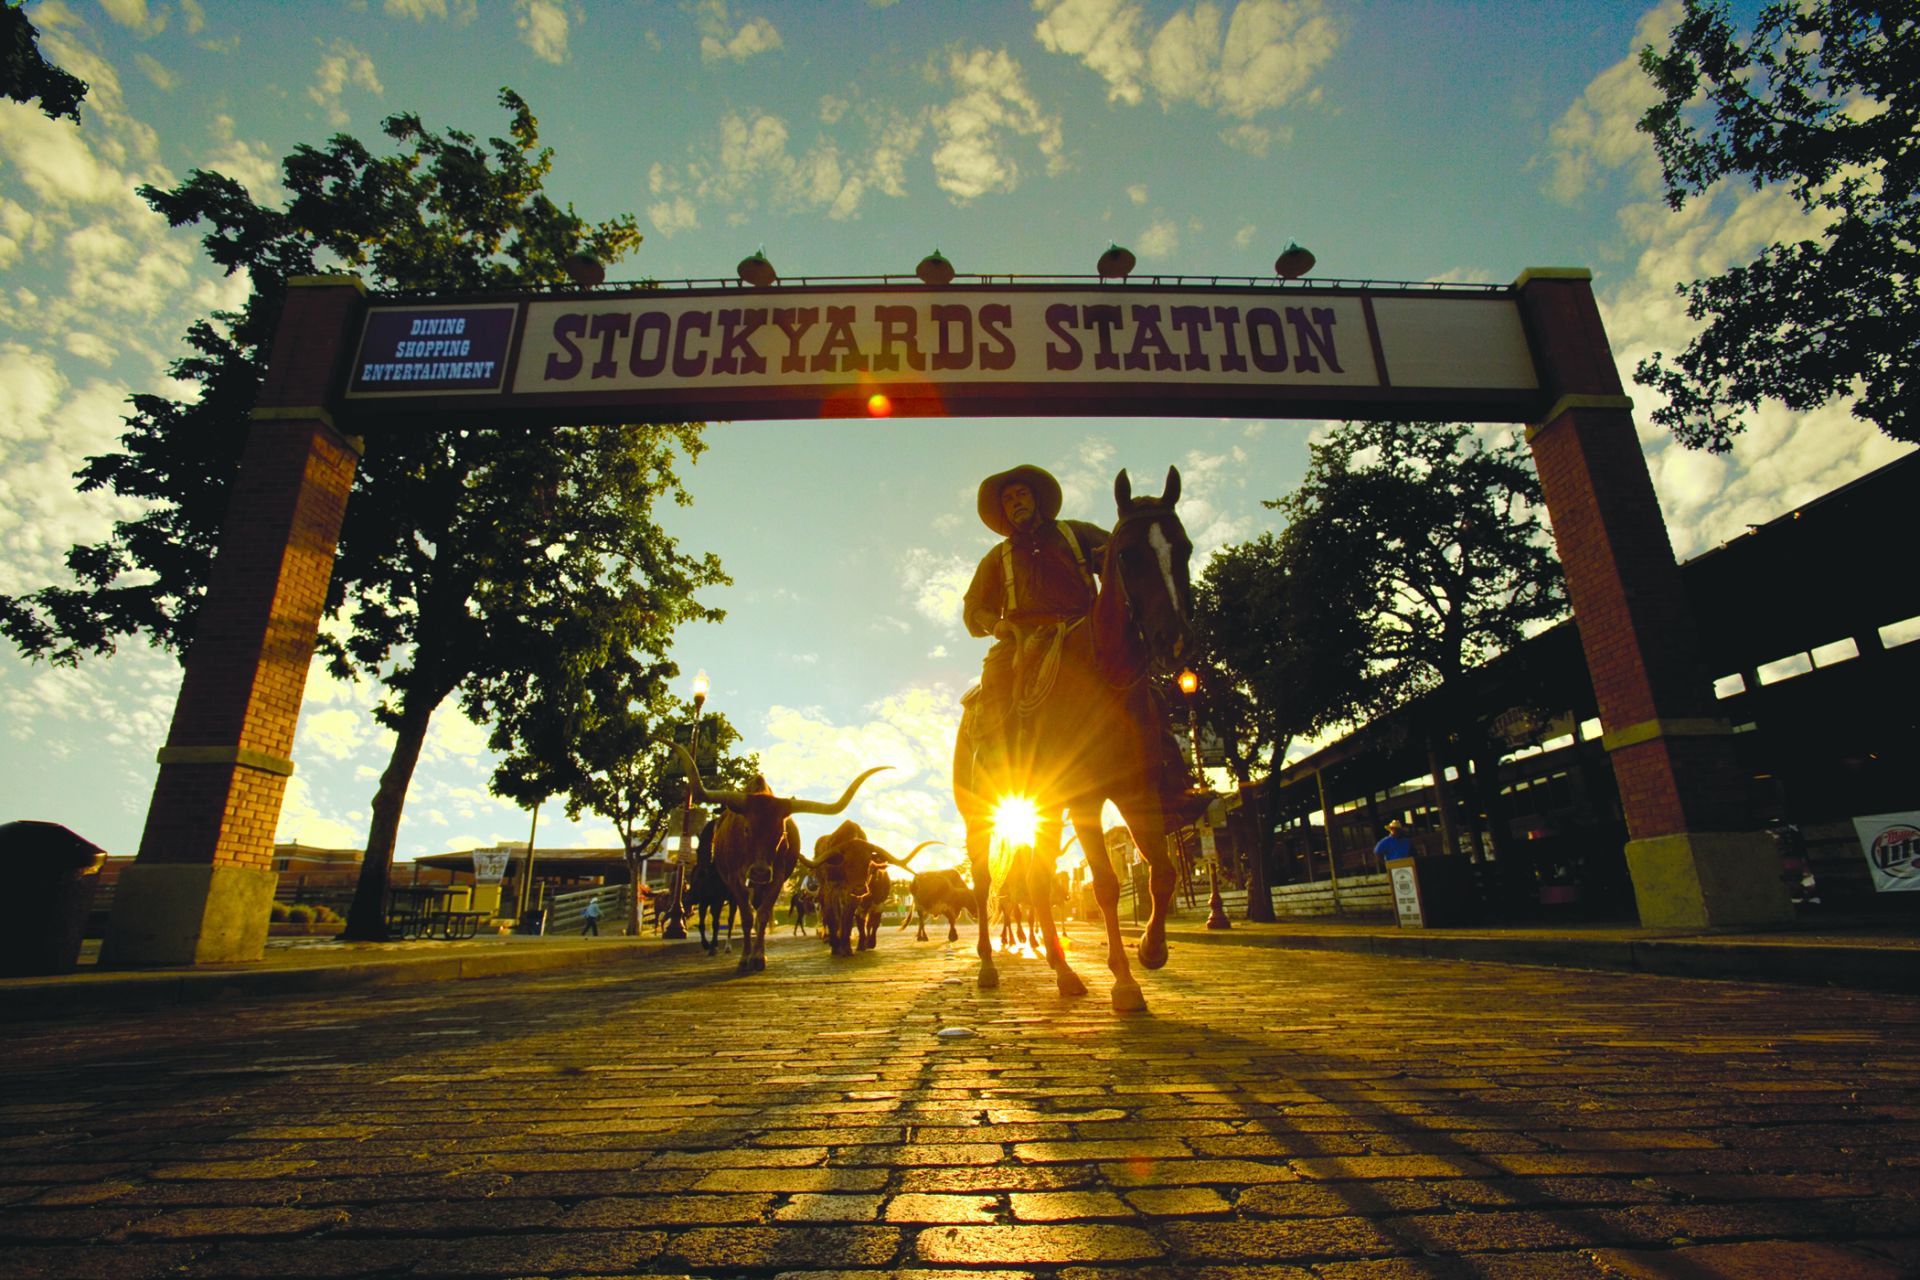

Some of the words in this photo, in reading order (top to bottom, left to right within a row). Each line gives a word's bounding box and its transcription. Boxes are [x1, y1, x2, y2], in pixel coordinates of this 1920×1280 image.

[410, 318, 466, 336] DINING
[395, 340, 471, 358] SHOPPING
[543, 303, 1017, 382] STOCKYARDS
[1044, 303, 1345, 374] STATION
[361, 361, 495, 381] ENTERTAINMENT
